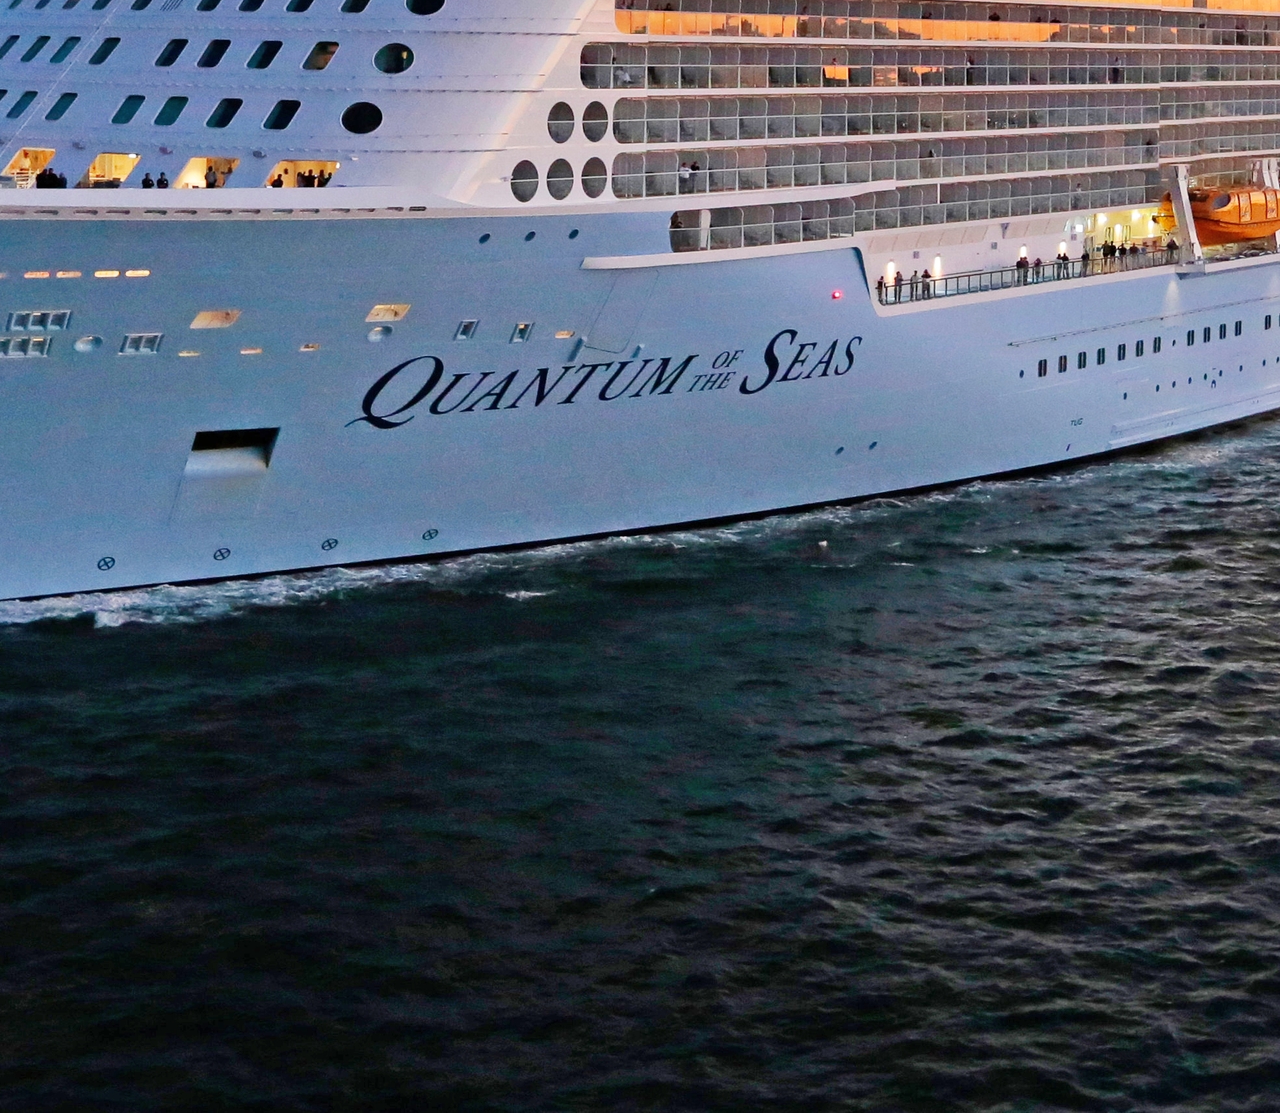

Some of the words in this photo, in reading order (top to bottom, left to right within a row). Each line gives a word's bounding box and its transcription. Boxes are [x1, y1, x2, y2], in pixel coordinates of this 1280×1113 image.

[711, 349, 745, 369] OF
[739, 328, 863, 395] SEAS
[344, 353, 700, 430] QUANTUM
[686, 371, 737, 392] THE
